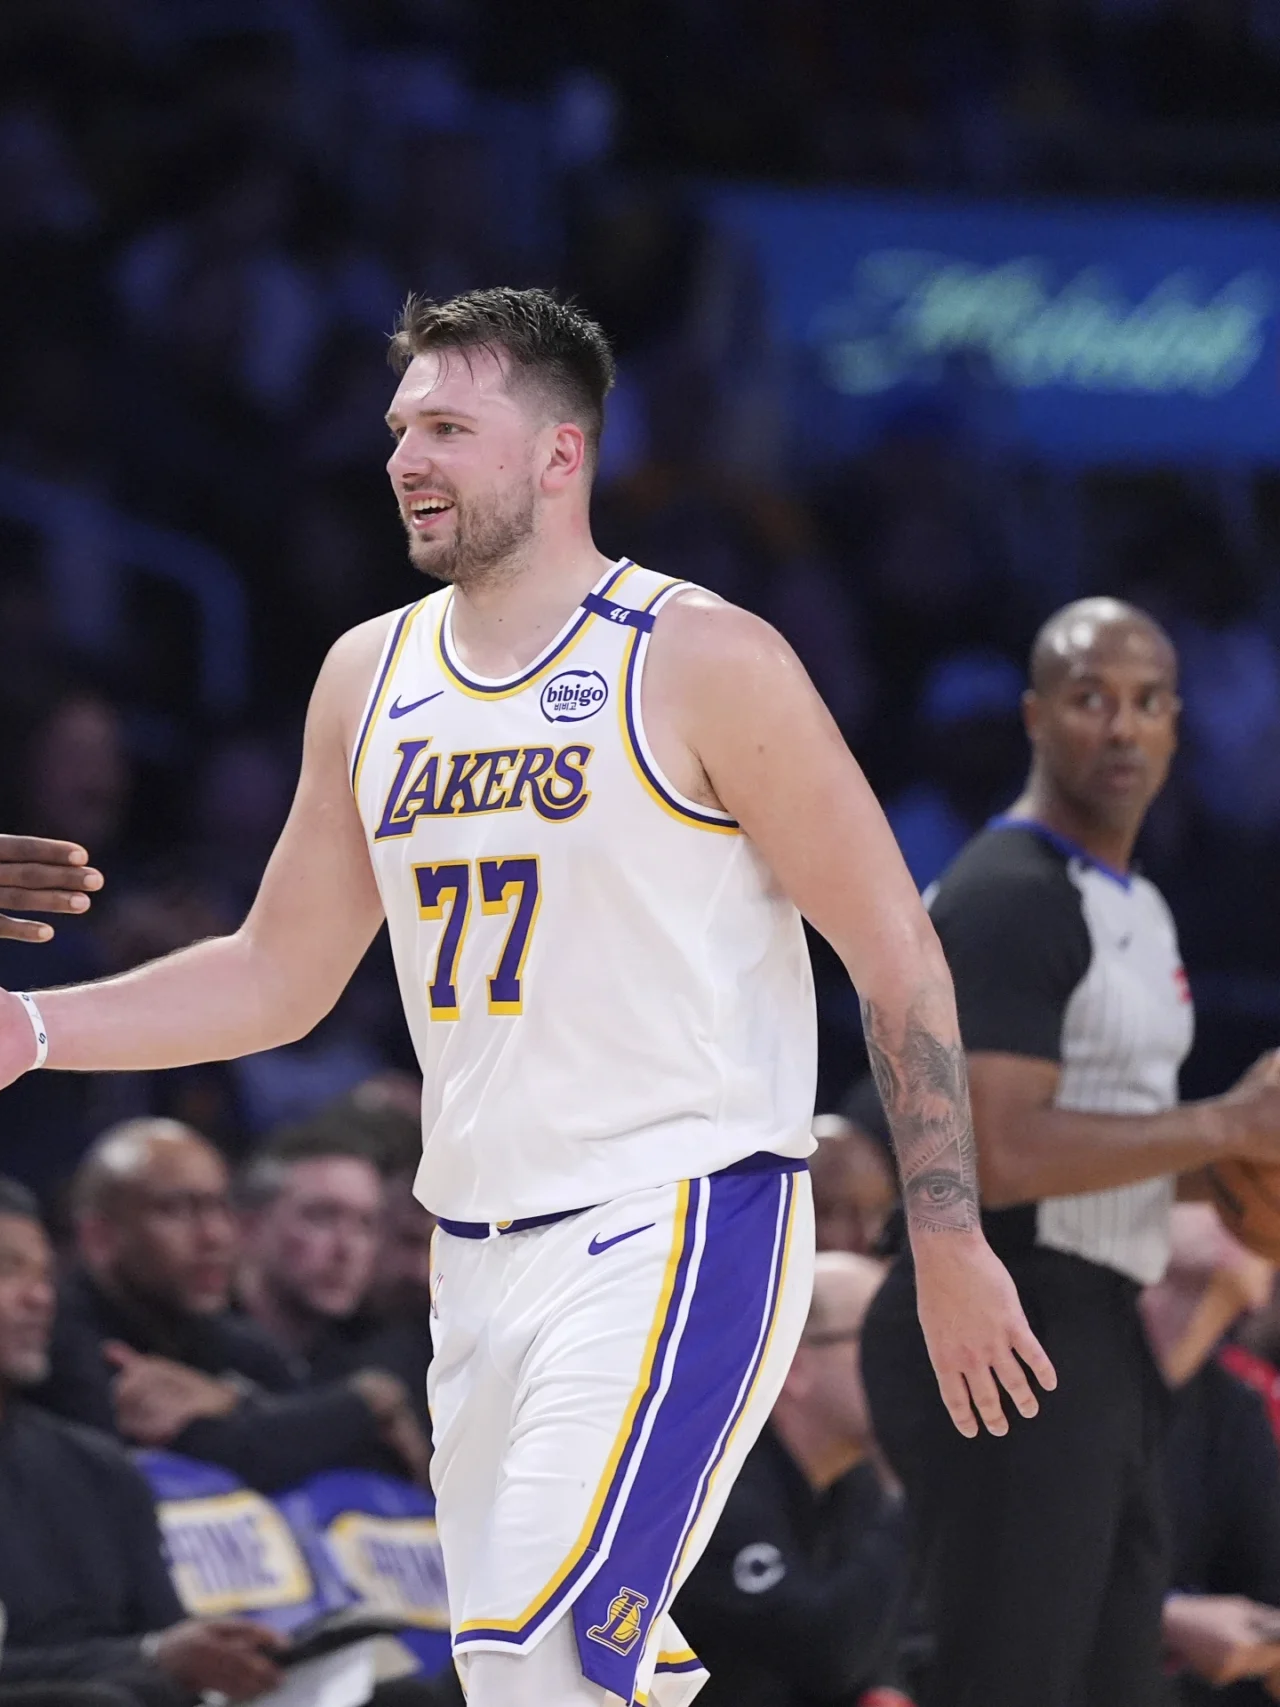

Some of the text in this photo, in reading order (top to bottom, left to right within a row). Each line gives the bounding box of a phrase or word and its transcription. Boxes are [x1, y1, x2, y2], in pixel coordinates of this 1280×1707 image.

[609, 607, 630, 623] 44
[546, 683, 604, 706] bibigo
[554, 701, 577, 711] 비비고
[373, 736, 595, 843] LAKERS
[411, 854, 542, 1021] 77
